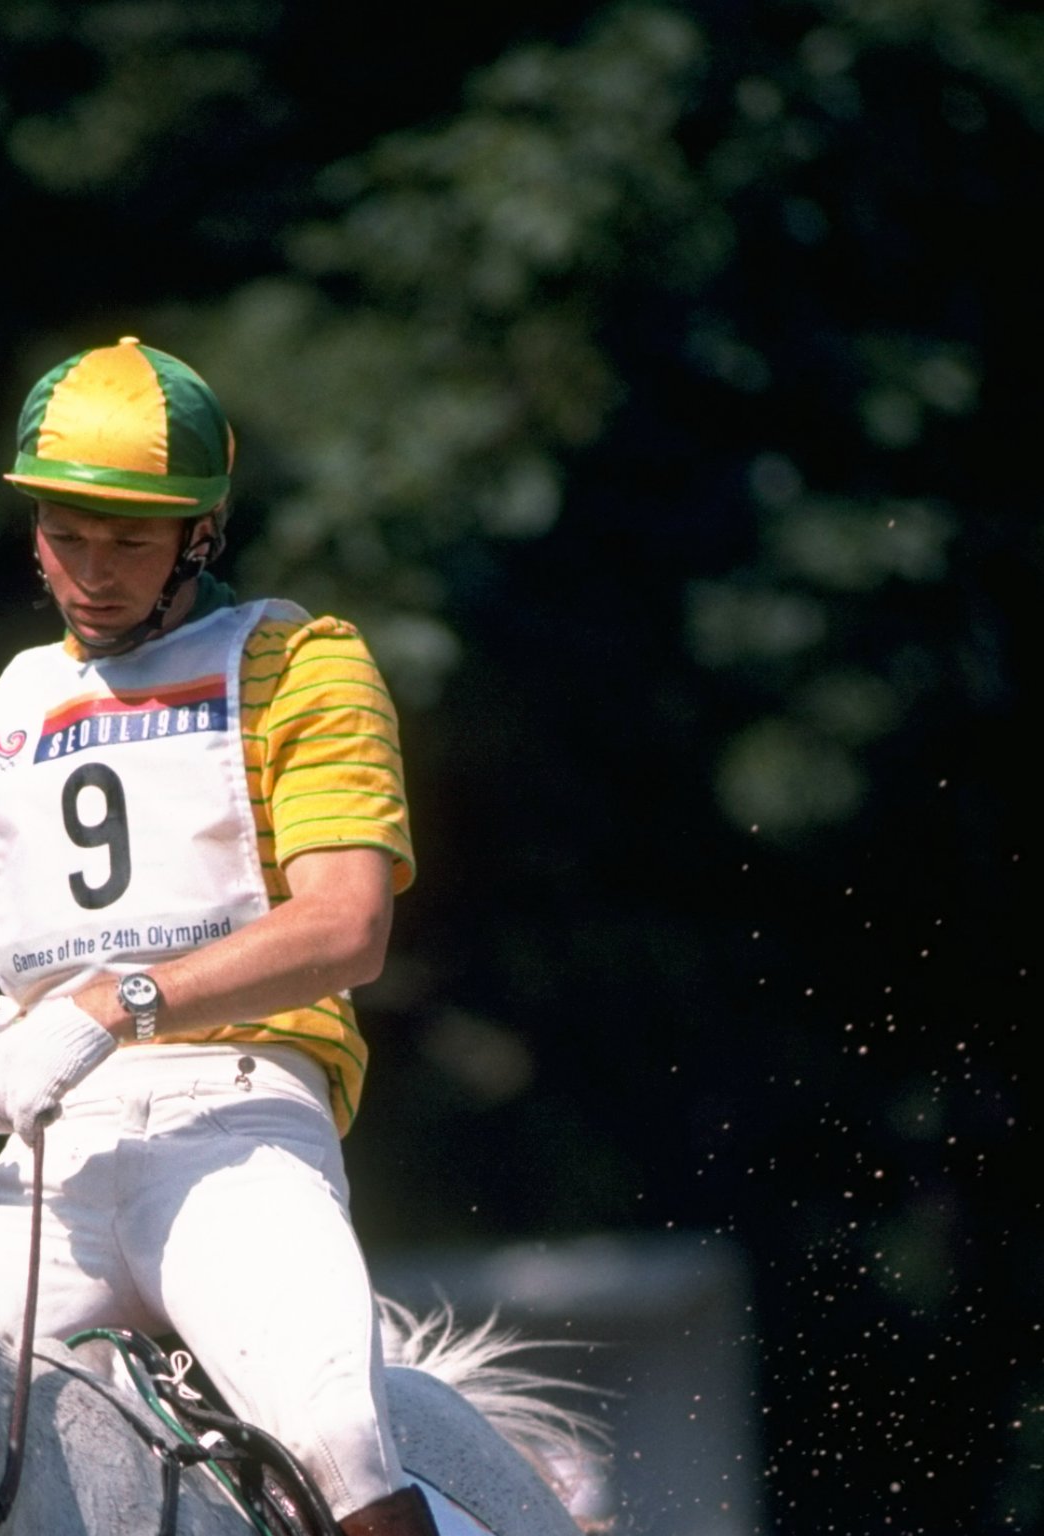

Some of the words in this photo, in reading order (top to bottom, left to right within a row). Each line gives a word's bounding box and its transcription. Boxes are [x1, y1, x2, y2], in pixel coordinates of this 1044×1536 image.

[48, 715, 130, 758] SEOUL
[142, 702, 211, 739] 1988
[61, 762, 132, 911] 9
[12, 946, 54, 974] Games
[57, 942, 72, 962] of
[73, 939, 96, 959] the
[101, 928, 141, 950] 24th
[148, 917, 232, 948] Olympiad
